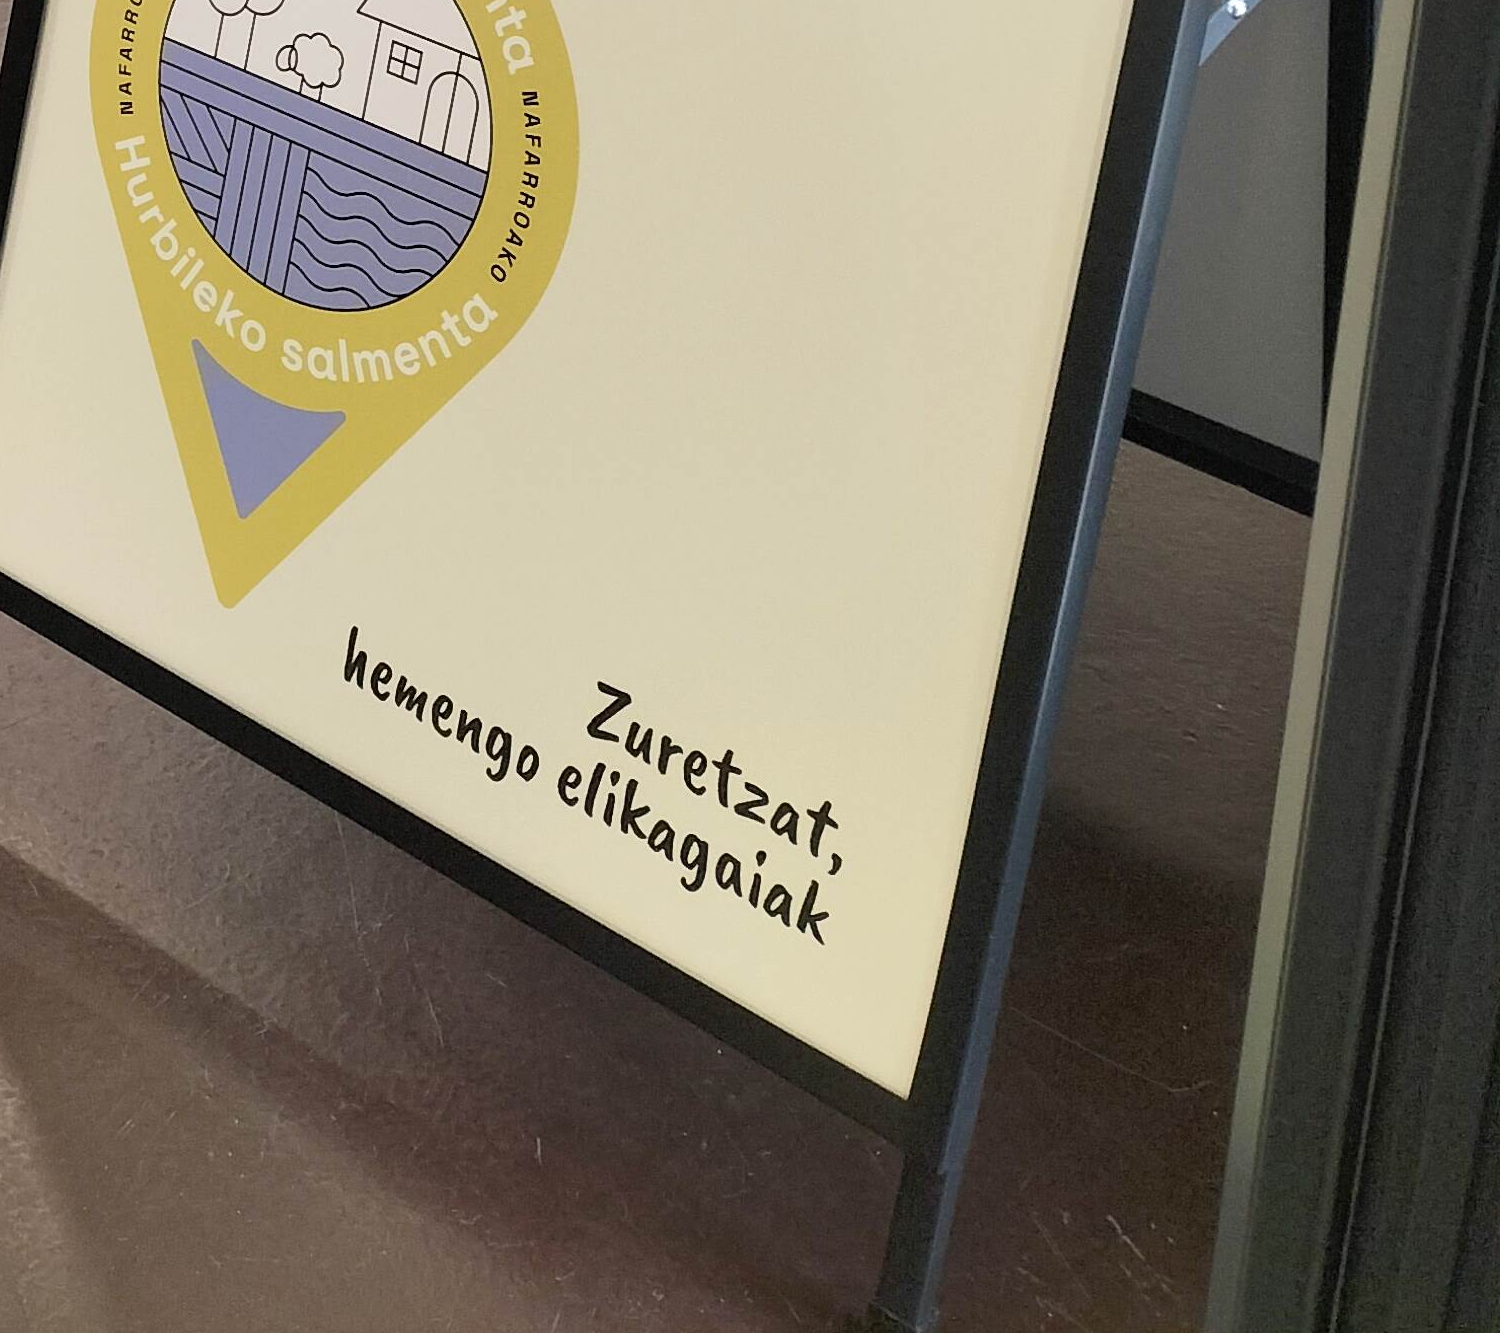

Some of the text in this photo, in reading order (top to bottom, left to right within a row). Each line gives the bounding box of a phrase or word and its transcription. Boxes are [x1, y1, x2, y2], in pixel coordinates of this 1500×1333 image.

[114, 135, 500, 384] Hurbileko salmenta
[490, 90, 542, 284] NAFARROAKO
[342, 626, 831, 945] hemengo elikagaiak
[586, 681, 843, 876] Zuretzat,
